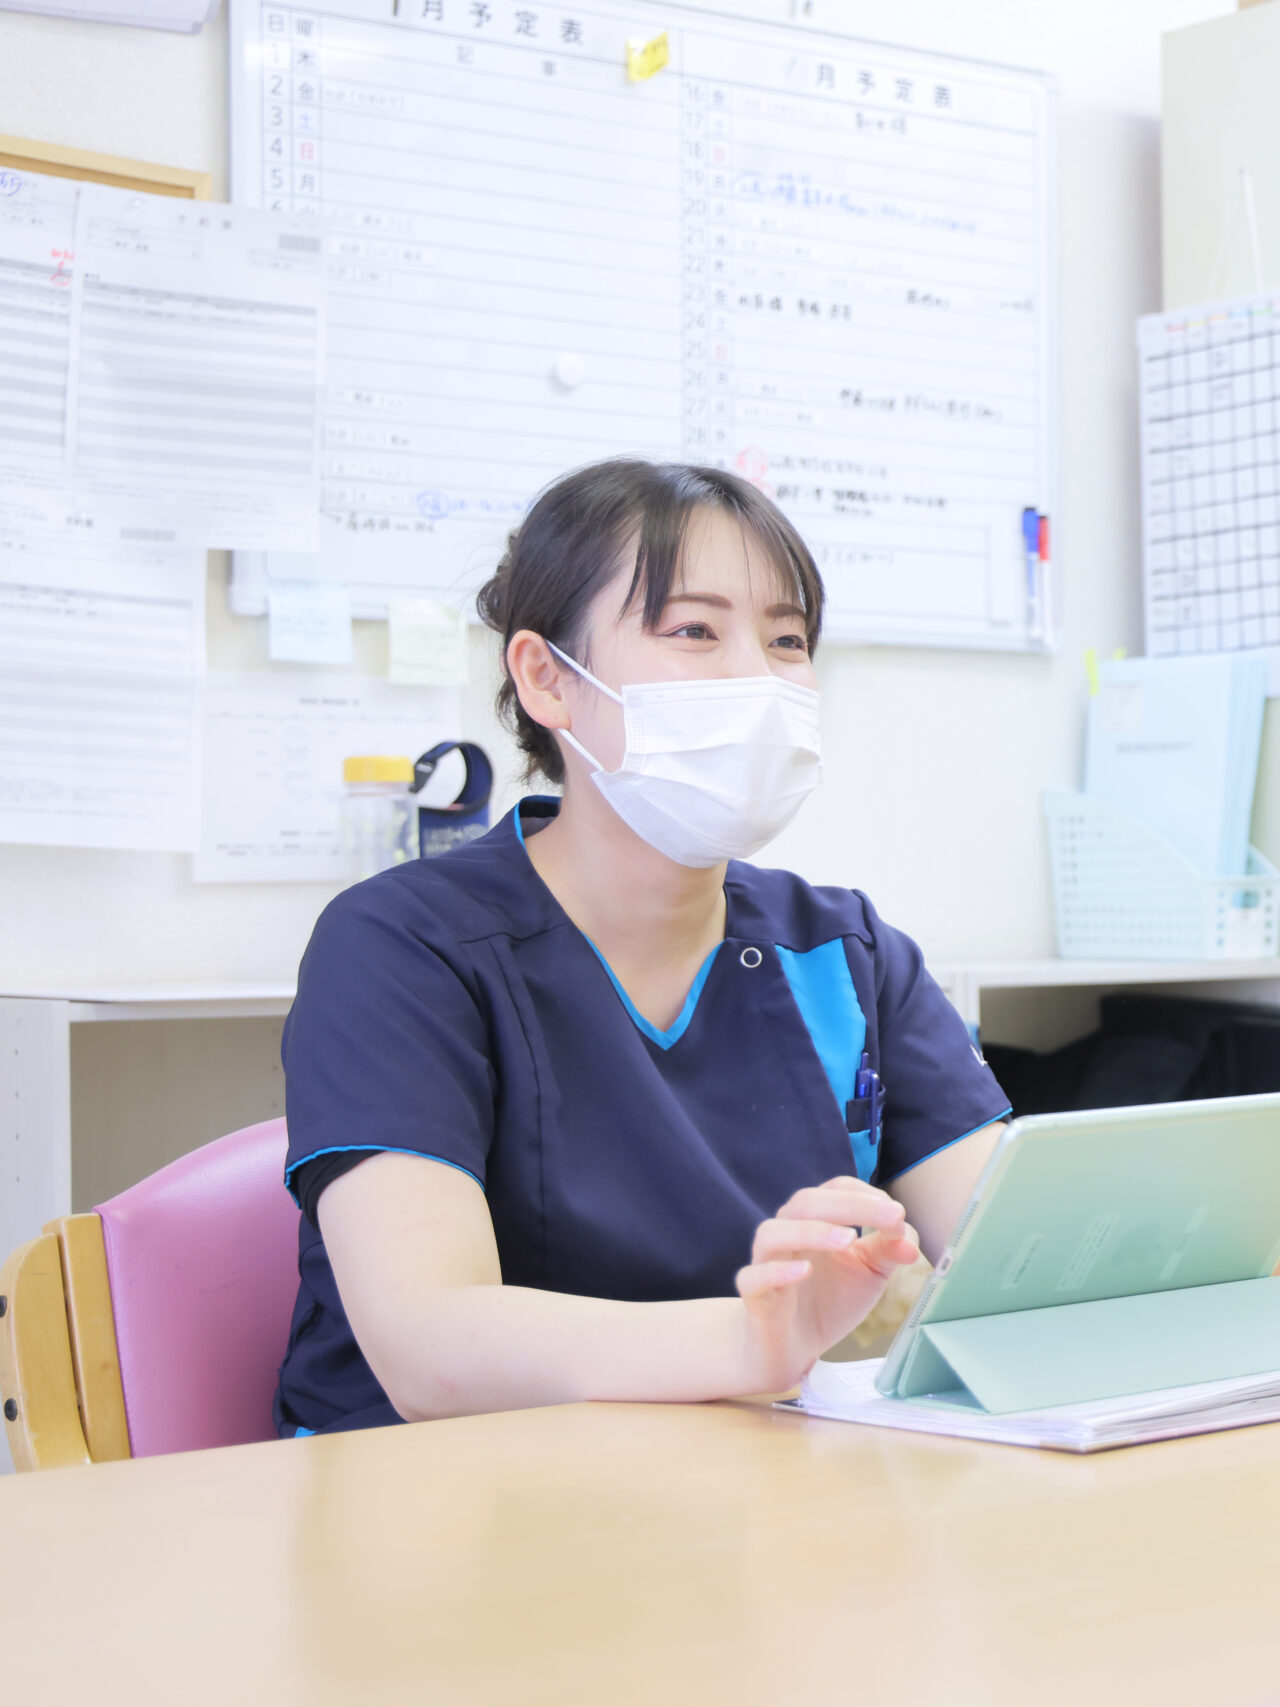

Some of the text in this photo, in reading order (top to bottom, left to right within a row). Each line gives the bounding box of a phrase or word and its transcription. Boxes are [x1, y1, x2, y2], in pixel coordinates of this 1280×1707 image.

[270, 74, 283, 96] 2
[270, 105, 283, 127] 3
[270, 136, 283, 157] 4
[270, 167, 284, 189] 5
